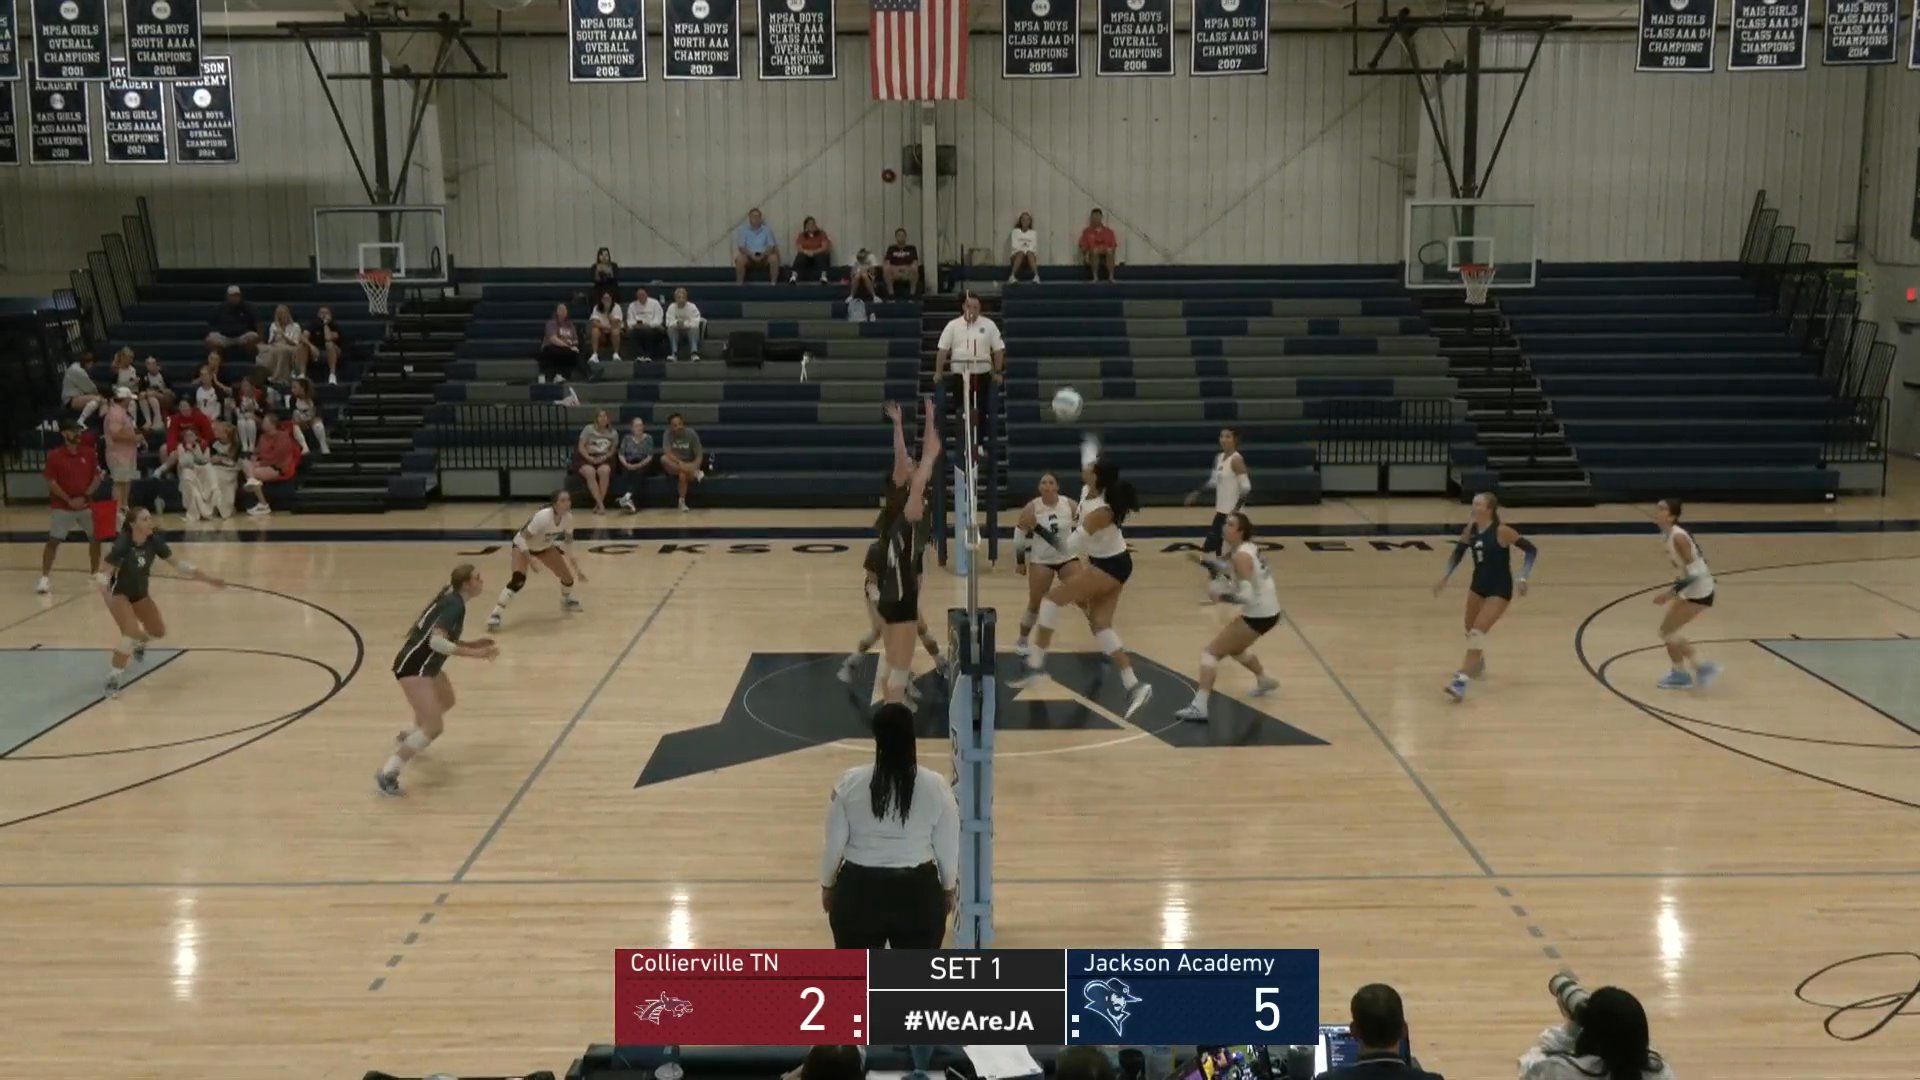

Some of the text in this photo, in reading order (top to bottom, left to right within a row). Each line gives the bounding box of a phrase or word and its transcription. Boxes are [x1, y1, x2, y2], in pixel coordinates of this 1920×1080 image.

[1742, 5, 1798, 17] MAIS GIRLS
[1837, 2, 1888, 13] MAIS BOYS
[769, 12, 824, 23] MPSA BOYS
[1110, 11, 1162, 23] MPSA BOYS
[1650, 14, 1706, 25] MAIS GIRLS
[1828, 14, 1858, 24] CLASS
[1859, 14, 1880, 24] AAA
[580, 17, 634, 29] MPSA GIRLS
[674, 23, 729, 34] MPSA BOYS
[769, 23, 824, 33] NORTH AAA
[1014, 20, 1069, 32] MPSA BOYS
[1204, 17, 1257, 29] MPSA BOYS
[1736, 18, 1766, 29] CLASS
[1768, 18, 1789, 28] AAA
[42, 24, 99, 36] MPSA GIRLS
[136, 24, 189, 35] MPSA BOYS
[1103, 24, 1133, 35] CLASS
[1135, 24, 1155, 35] AAA
[1643, 28, 1675, 39] CLASS
[1675, 28, 1697, 39] AAA
[1833, 25, 1887, 35] CLASS AAA
[576, 30, 638, 41] SOUTH AAAA
[769, 33, 824, 44] CLASS AAA
[1008, 34, 1038, 45] CLASS
[1040, 34, 1061, 45] AAA
[1196, 32, 1227, 43] CLASS
[1229, 31, 1250, 42] AAA
[1741, 30, 1795, 41] CLASS AAA
[1832, 35, 1888, 47] CHAMPIONS
[49, 38, 94, 49] OVERALL
[131, 38, 196, 48] SOUTH AAAA
[673, 37, 729, 48] NORTH AAA
[1113, 36, 1158, 47] OVERALL
[1648, 41, 1704, 53] CHAMPIONS
[1740, 41, 1796, 53] CHAMPIONS
[585, 42, 629, 53] OVERALL
[774, 44, 820, 55] OVERALL
[1202, 44, 1257, 57] CHAMPIONS
[1848, 47, 1869, 57] 2014
[44, 52, 100, 63] CHAMPIONS
[137, 52, 192, 62] CHAMPIONS
[674, 50, 729, 61] CHAMPIONS
[1014, 48, 1069, 59] CHAMPIONS
[1109, 48, 1163, 59] CHAMPIONS
[581, 54, 635, 65] CHAMPIONS
[770, 55, 825, 66] CHAMPIONS
[1218, 59, 1242, 70] 2007
[1662, 56, 1686, 67] 2010
[1756, 54, 1777, 65] 2011
[61, 66, 84, 76] 2001
[154, 65, 176, 76] 2001
[596, 66, 620, 77] 2002
[690, 64, 713, 75] 2003
[784, 65, 810, 76] 2004
[1029, 62, 1053, 73] 2005
[56, 112, 81, 121] GIRLS
[110, 110, 158, 120] MAIS GIRLS
[205, 111, 224, 119] BOYS
[32, 124, 55, 134] CLASS
[107, 122, 162, 131] CLASS AAAAA
[37, 136, 83, 146] CHAMPIONS
[111, 133, 159, 143] CHAMPIONS
[186, 139, 227, 148] CHAMPIONS
[127, 145, 146, 155] 2021
[457, 543, 850, 556] JCKSO
